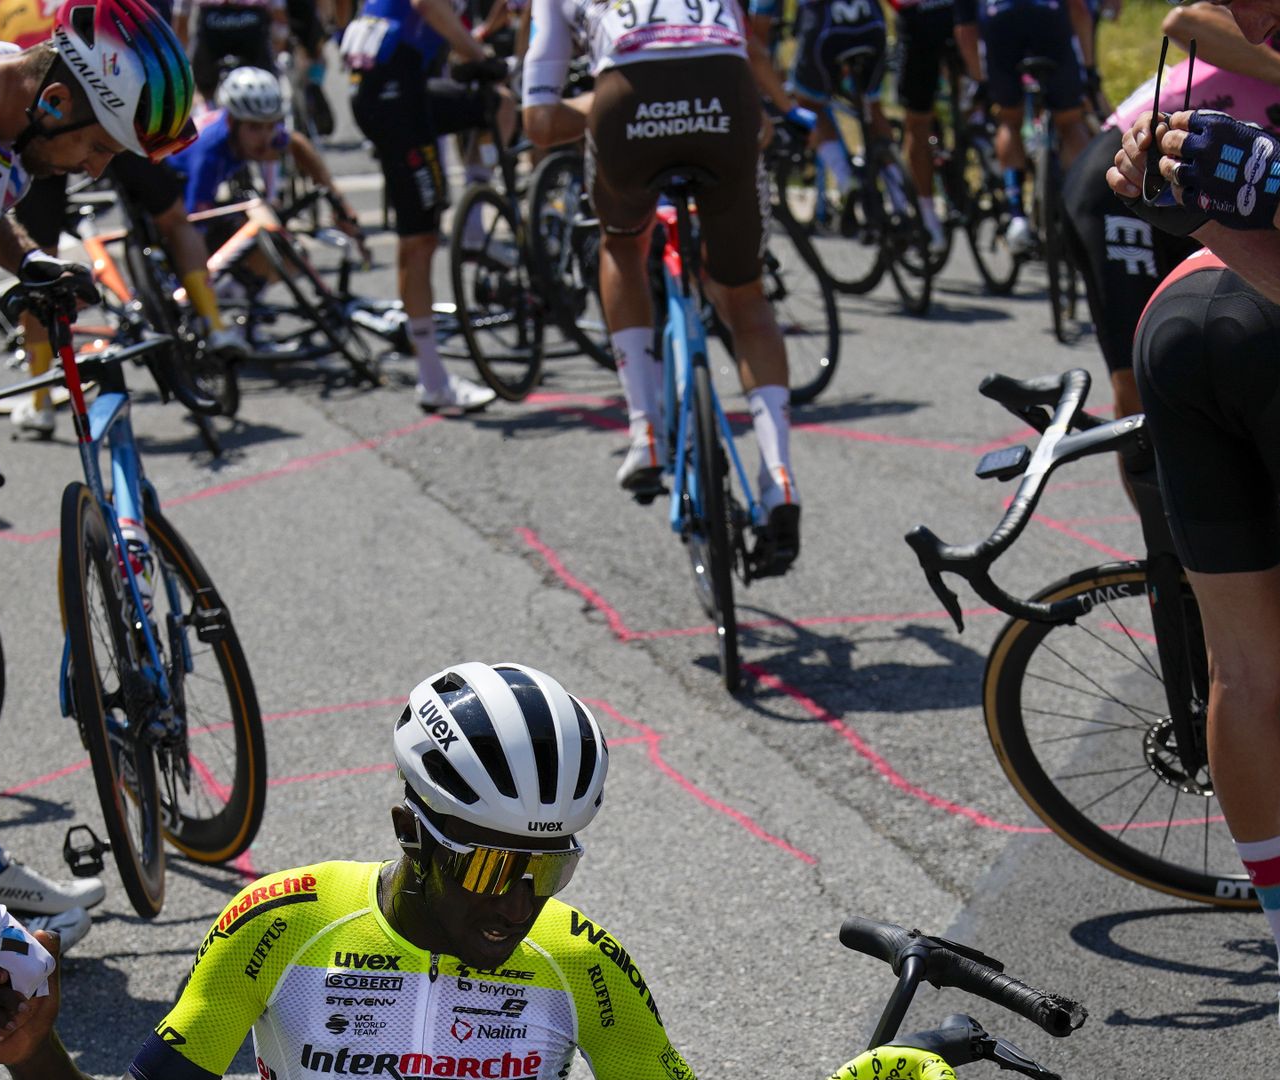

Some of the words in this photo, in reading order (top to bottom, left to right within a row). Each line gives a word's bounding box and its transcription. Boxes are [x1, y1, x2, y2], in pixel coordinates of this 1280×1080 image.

[635, 101, 690, 120] AG2R
[695, 97, 723, 114] LA
[625, 116, 732, 140] MONDIALE
[418, 699, 460, 753] uvex
[527, 820, 564, 832] uvex
[244, 916, 289, 982] RUFFUS
[334, 951, 402, 971] uvex
[328, 973, 400, 990] GOBERT
[325, 995, 397, 1007] STEVENY
[586, 963, 615, 1028] RUFFUS
[354, 1021, 387, 1029] WORLD
[355, 1014, 374, 1022] UCI
[353, 1028, 378, 1036] TEAM
[477, 1024, 528, 1039] Nalini
